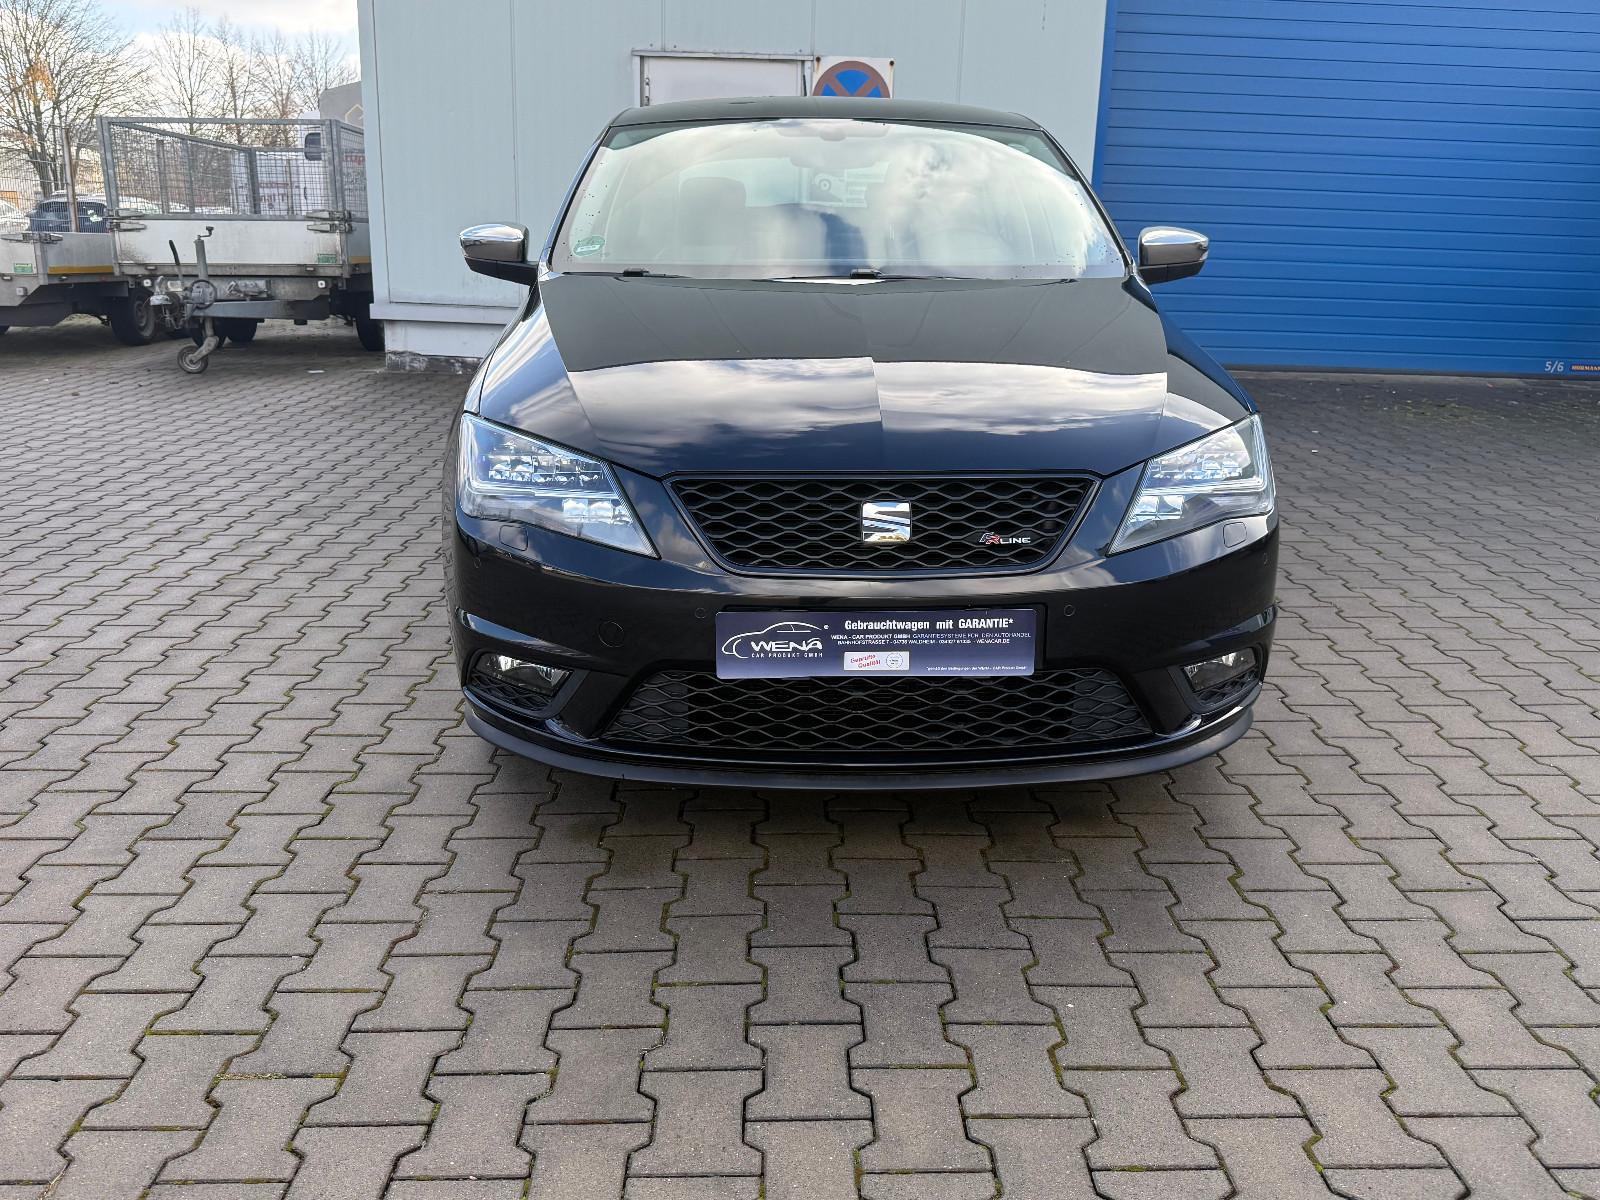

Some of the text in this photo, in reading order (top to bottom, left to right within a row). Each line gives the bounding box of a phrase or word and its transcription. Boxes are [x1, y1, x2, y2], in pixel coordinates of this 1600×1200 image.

[1545, 360, 1564, 373] 5/6
[844, 620, 930, 631] Gebrauchtwagen
[936, 619, 954, 629] mit
[750, 638, 823, 651] WENA
